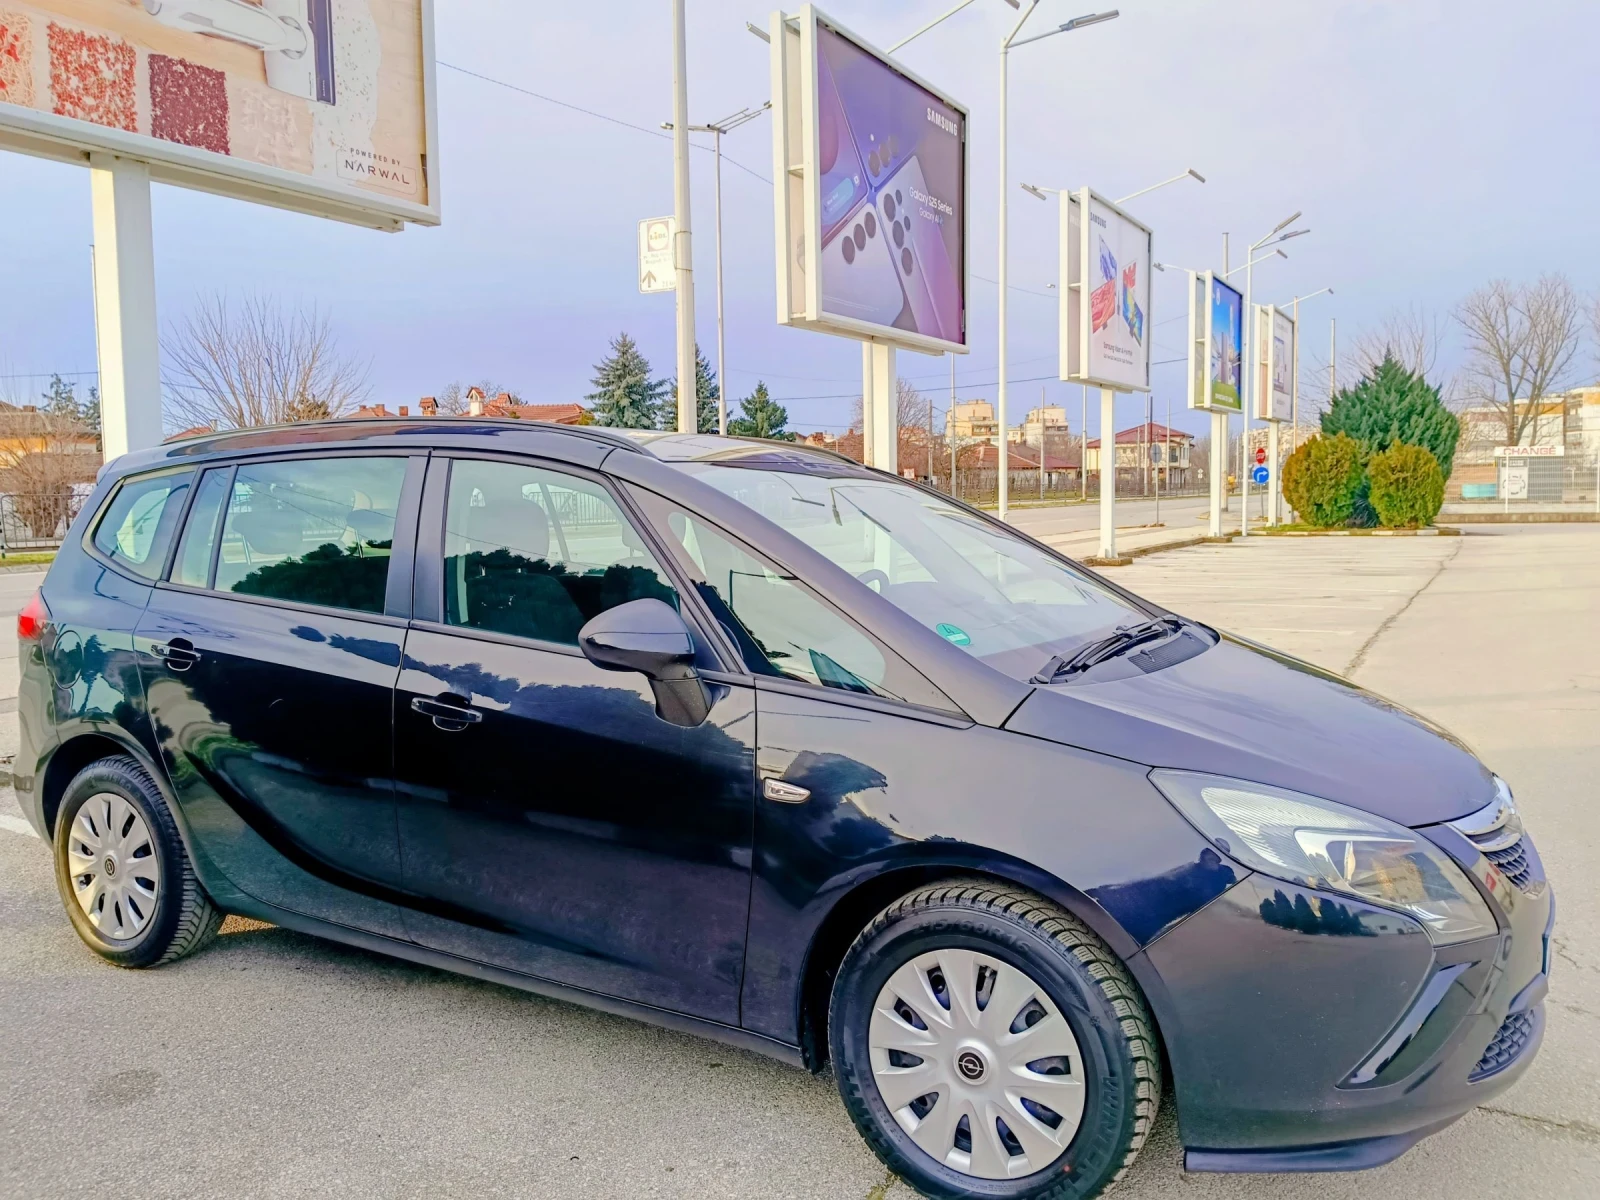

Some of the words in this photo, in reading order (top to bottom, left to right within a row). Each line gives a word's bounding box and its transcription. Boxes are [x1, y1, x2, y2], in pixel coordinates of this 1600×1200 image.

[927, 107, 958, 137] SAMSUNG
[350, 147, 387, 163] POWERED
[391, 158, 400, 166] BY
[345, 159, 410, 185] NARWAL
[909, 186, 929, 206] Galaxy
[928, 195, 938, 209] S25
[937, 199, 953, 216] Series
[919, 207, 934, 225] Galaxy
